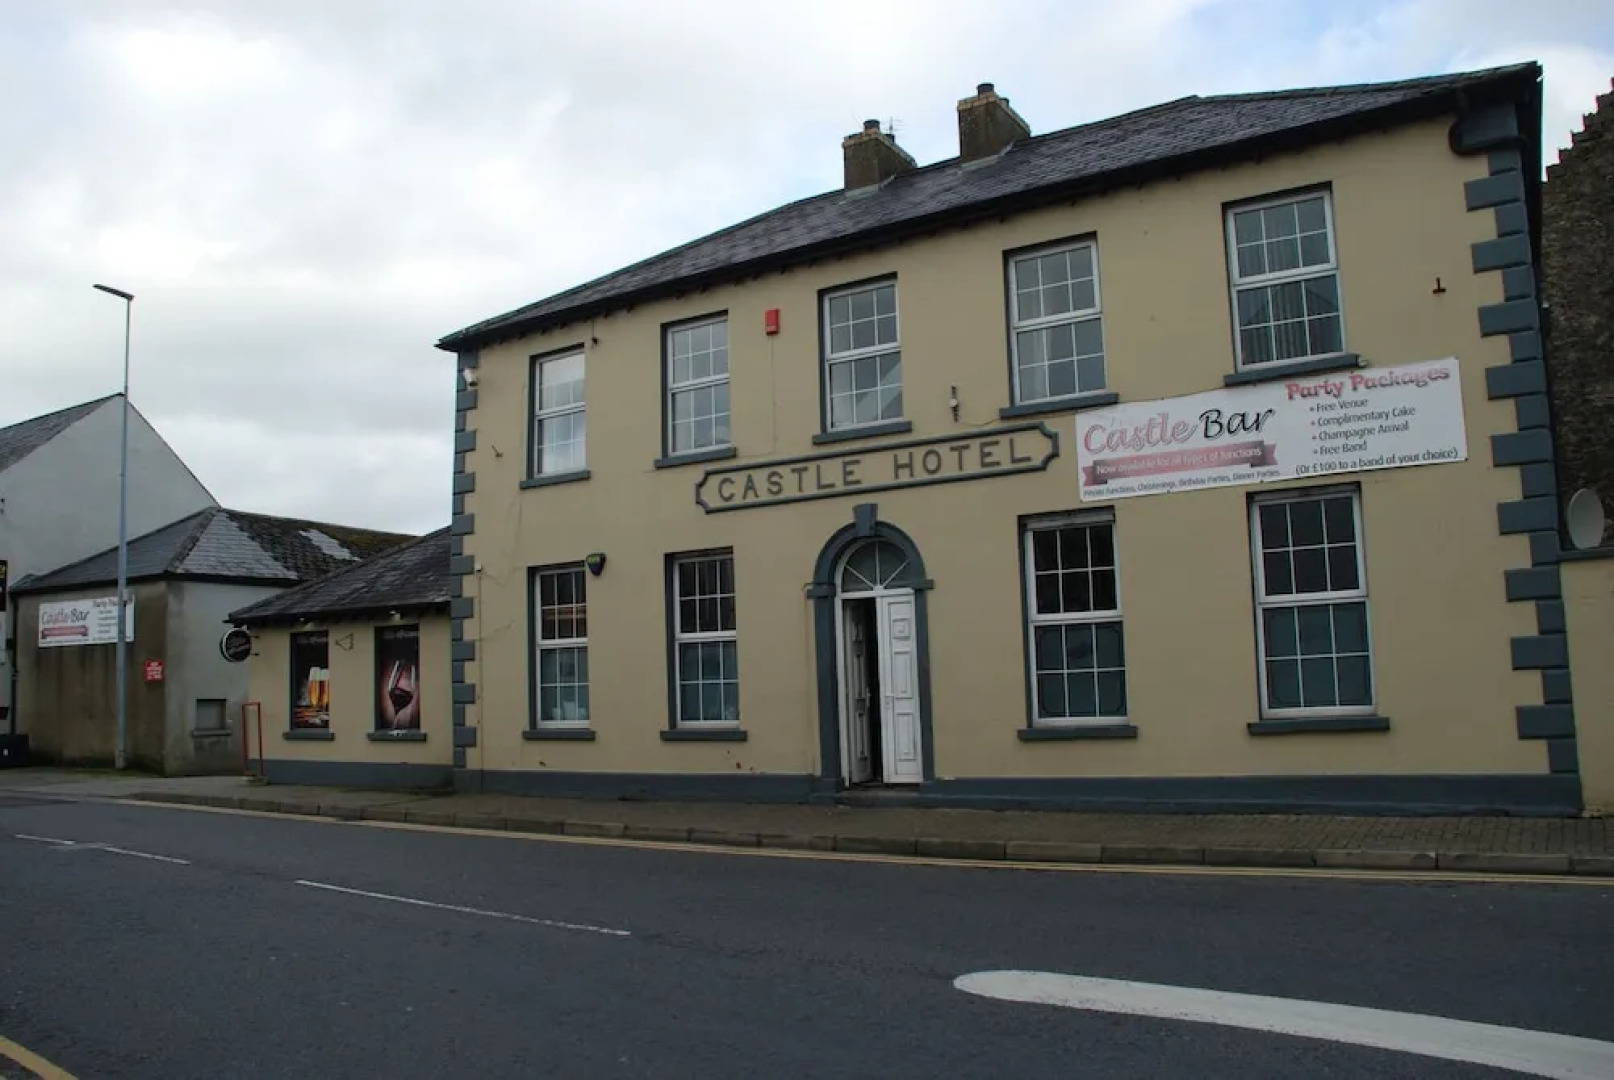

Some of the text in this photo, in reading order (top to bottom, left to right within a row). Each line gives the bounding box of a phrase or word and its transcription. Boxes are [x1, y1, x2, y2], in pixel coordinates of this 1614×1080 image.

[1285, 368, 1450, 400] Party Packages
[1316, 398, 1369, 413] Free Venue
[1317, 406, 1416, 428] Complimentary Cake
[1084, 406, 1276, 454] Castle Bar
[1318, 421, 1409, 441] Champagne Arrival
[1319, 440, 1368, 456] Free Band
[717, 437, 1033, 503] CASTLE HOTEL
[1096, 464, 1116, 475] Now
[1313, 460, 1337, 473] £100
[1338, 459, 1349, 469] to
[1358, 454, 1384, 467] band
[1386, 453, 1396, 465] of
[1397, 452, 1420, 464] your
[1422, 446, 1459, 460] choice)
[70, 607, 90, 623] Bar
